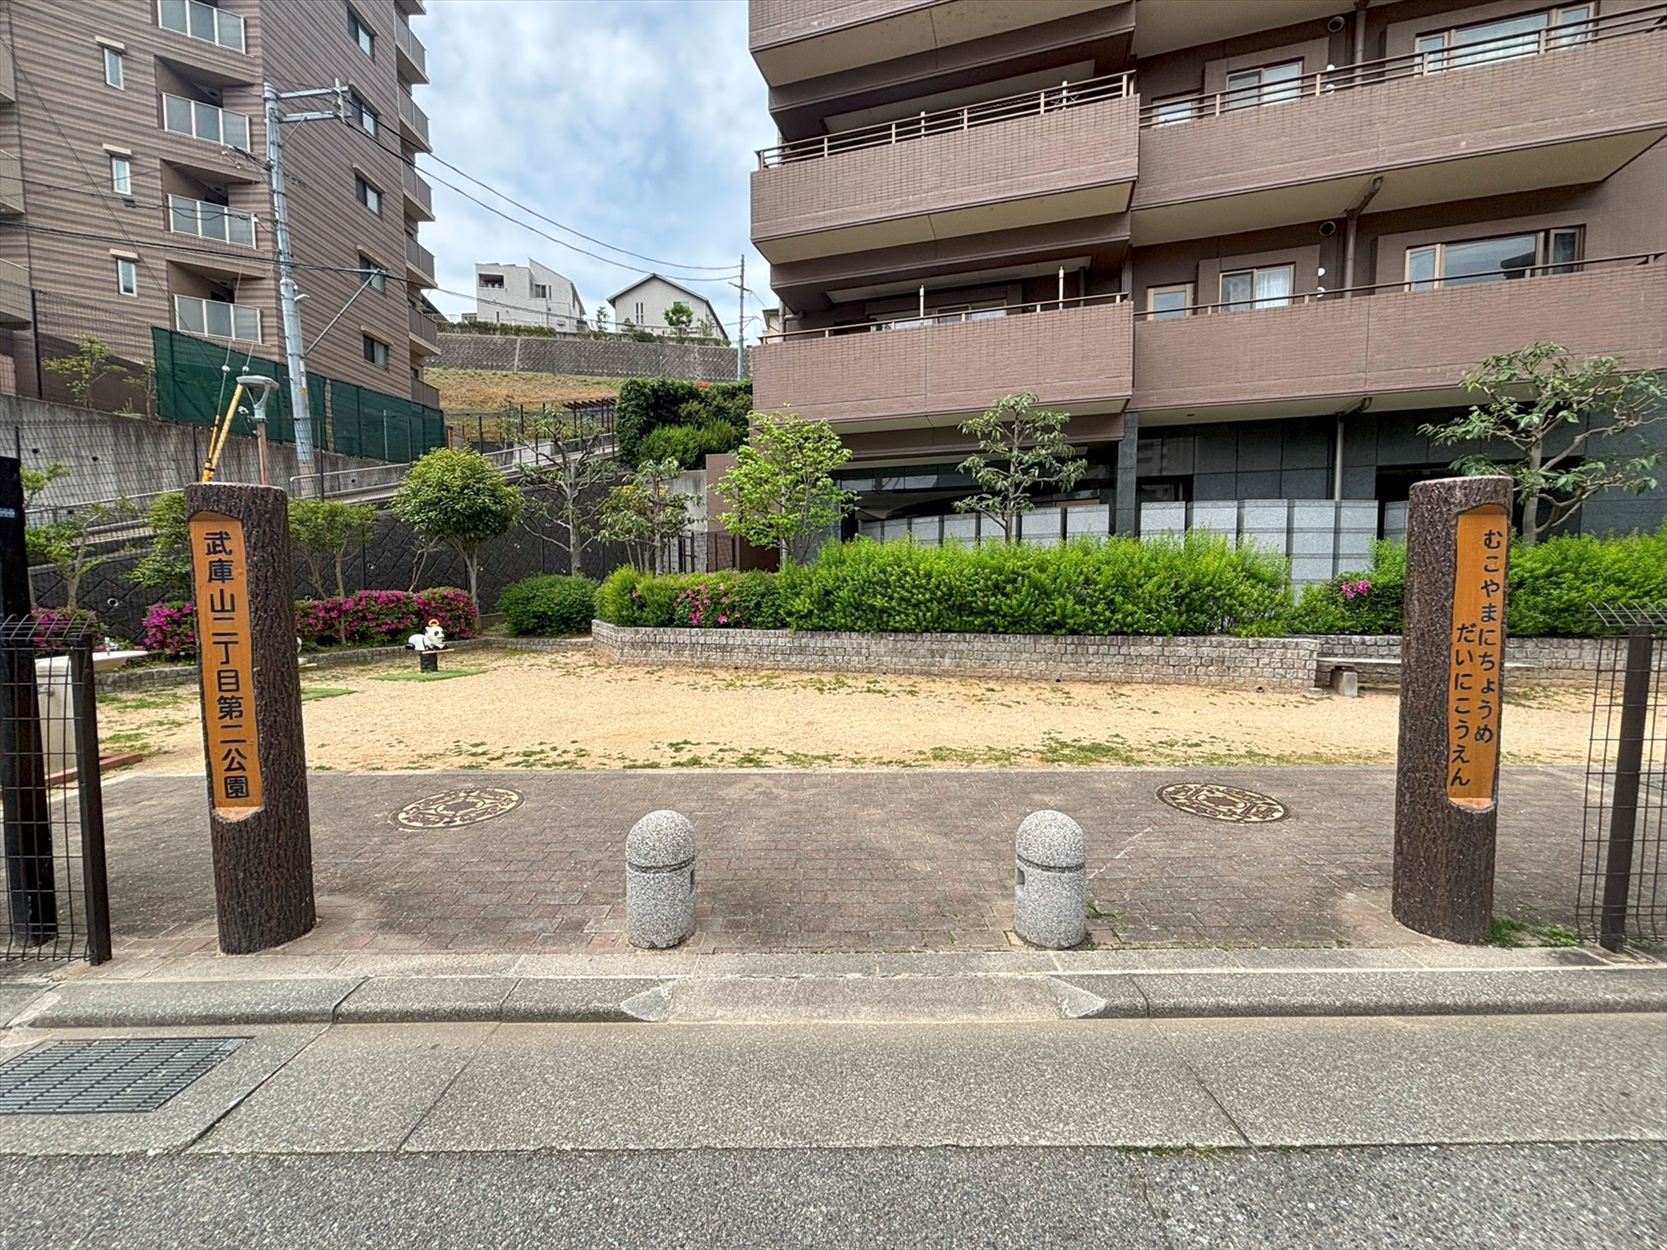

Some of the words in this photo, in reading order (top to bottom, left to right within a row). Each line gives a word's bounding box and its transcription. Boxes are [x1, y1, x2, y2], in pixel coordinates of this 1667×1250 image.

[204, 531, 249, 799] 武庫山二丁目第二公園
[1450, 623, 1477, 787] だいにこうえん
[1474, 529, 1502, 744] むこやまにちょうめ
